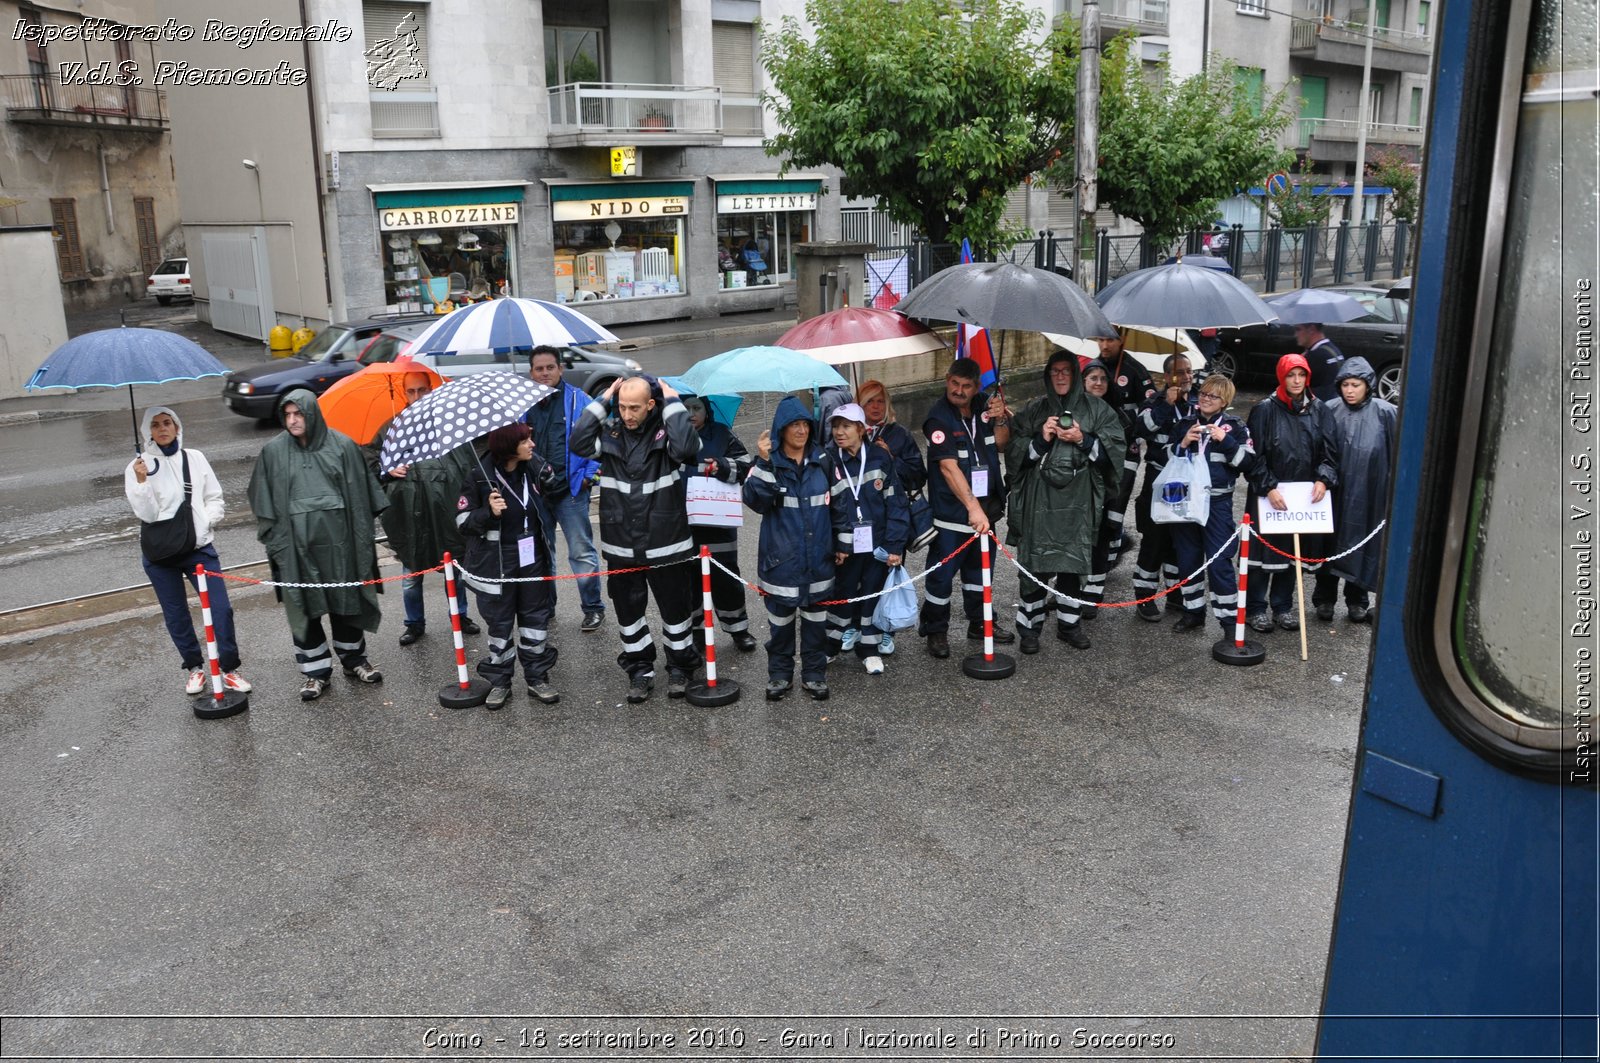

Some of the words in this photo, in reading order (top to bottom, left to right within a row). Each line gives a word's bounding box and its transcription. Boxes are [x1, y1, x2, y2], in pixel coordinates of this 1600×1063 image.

[590, 200, 650, 216] NIDO
[732, 195, 804, 210] LETTINI
[383, 206, 516, 227] CARROZZINE
[1265, 511, 1327, 522] PIEMONTE
